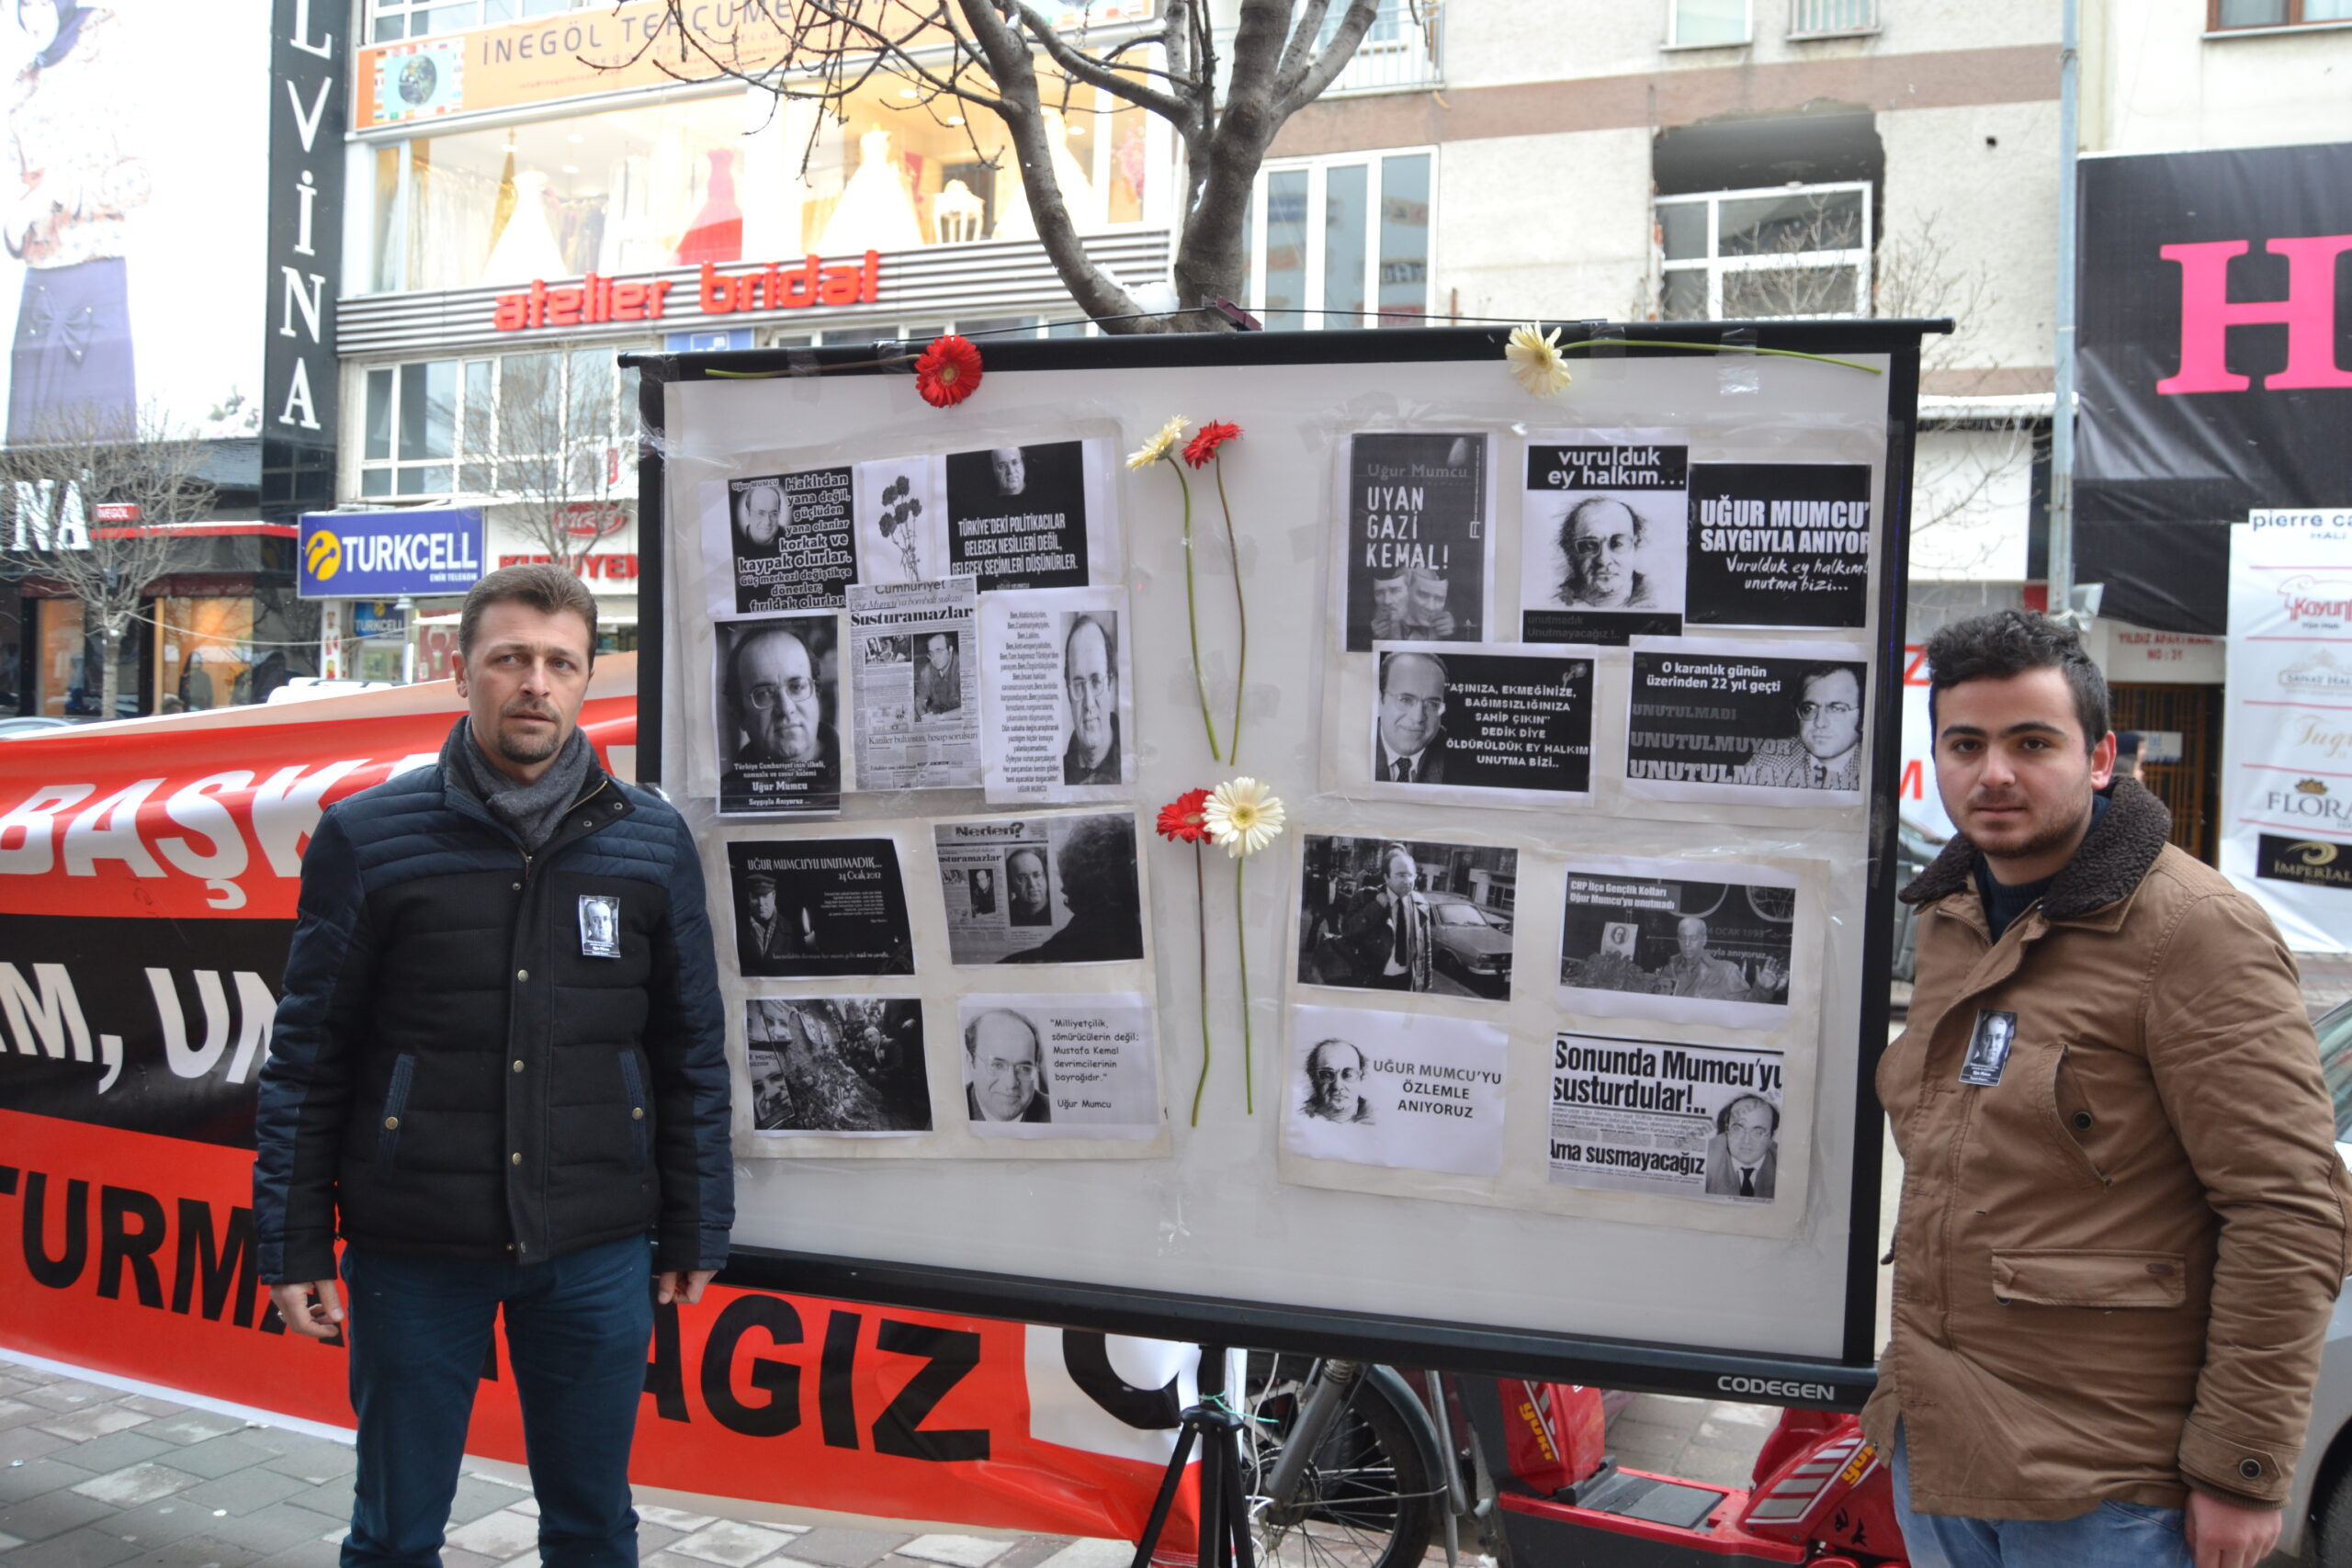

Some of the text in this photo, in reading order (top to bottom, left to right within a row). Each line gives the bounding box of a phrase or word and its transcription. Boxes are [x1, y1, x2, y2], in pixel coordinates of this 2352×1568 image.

[481, 23, 603, 66] İNEGÖL
[492, 250, 879, 331] atelier bridal
[1558, 447, 1661, 466] vurulduk
[1368, 463, 1468, 480] Uğur Mumcu
[1548, 467, 1685, 490] ey halkım...
[786, 473, 848, 491] Haklıdan
[787, 490, 852, 506] yana değil,
[1368, 486, 1424, 511] UYAN
[794, 506, 843, 522] güçlüden
[1700, 494, 1765, 526] UĞUR
[786, 519, 850, 537] yana olanlar
[957, 513, 1066, 536] TÜRKİYE'DEKİ POLİTİKACILAR
[1367, 511, 1418, 540] GAZİ
[2253, 512, 2324, 532] pierre
[779, 535, 849, 553] korkak ve
[964, 531, 1063, 557] GELECEK NESİLLERİ DEĞİL,
[1700, 528, 1794, 553] SAYGIYLA
[342, 532, 478, 572] TURKCELL
[1366, 543, 1449, 570] KEMAL!
[738, 549, 853, 574] kaypak olurlar.
[952, 559, 984, 576] GELECEK
[984, 555, 1024, 577] SEÇİMLERİ
[1725, 554, 1788, 573] Vurulduk
[1792, 564, 1810, 580] ey
[740, 568, 853, 587] Güç merkezi değiştikçe
[1745, 579, 1797, 592] unutma
[750, 597, 798, 613] fırıldak
[851, 606, 974, 626] Susturamazlar
[1661, 661, 1768, 680] O karanlık günün
[1501, 683, 1577, 699] EKMEĞİNİZE,
[1646, 676, 1782, 694] üzerinden 22 yıl geçti
[1464, 696, 1571, 712] BAĞIMSIZLIĞINIZA
[1632, 704, 1737, 721] UNUTULMADI
[1475, 710, 1510, 722] SAHİP
[1481, 725, 1546, 739] DEDİK DİYE
[1446, 738, 1589, 755] ÖLDÜRÜLDÜK EY HALKIM
[1476, 754, 1526, 766] UNUTMA
[752, 781, 808, 794] Uğur Mumcu
[747, 857, 773, 871] UĞUR
[846, 870, 865, 881] Ocak
[1571, 880, 1588, 890] CHP
[1569, 892, 1590, 904] Uğur
[1634, 899, 1676, 909] unutmadı
[1051, 1032, 1111, 1042] sömürücülerin
[1053, 1046, 1119, 1055] Mustafa Kemal
[1555, 1039, 1657, 1078] Sonunda
[1054, 1060, 1117, 1068] devrimcilerinin
[1373, 1059, 1502, 1085] UĞUR MUMCU'YU
[1402, 1078, 1471, 1100] ÖZLEMLE
[1057, 1100, 1112, 1110] Uğur Mumcu
[1396, 1100, 1474, 1119] ANIYORUZ
[1586, 1146, 1706, 1176] susmayacağız
[1717, 1375, 1835, 1402] CODEGEN
